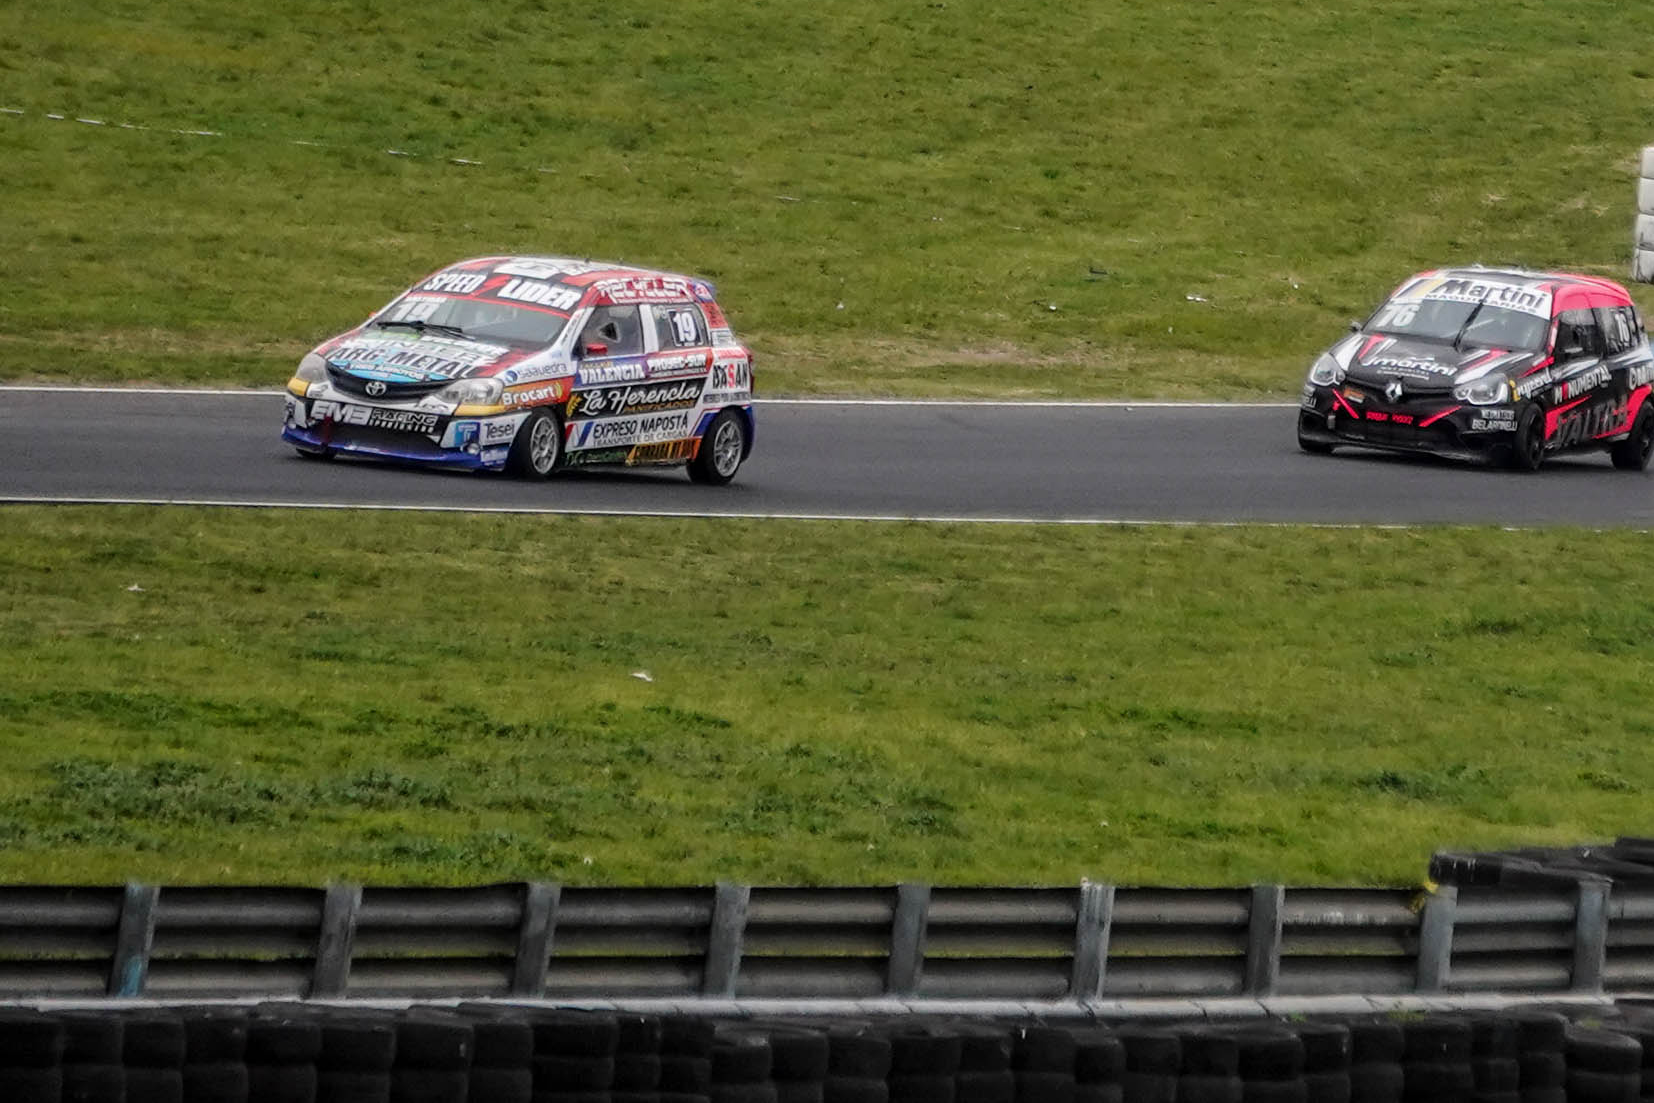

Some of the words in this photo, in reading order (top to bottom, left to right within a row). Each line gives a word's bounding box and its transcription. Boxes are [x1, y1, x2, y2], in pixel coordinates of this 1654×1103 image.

[422, 272, 488, 294] SPEED
[496, 278, 582, 311] LIDER
[1430, 279, 1547, 309] Martini
[672, 311, 698, 343] 19
[388, 351, 476, 380] METAL
[579, 364, 646, 386] VALENCIA
[502, 385, 555, 405] Brocart
[371, 409, 439, 427] RACING
[485, 419, 515, 439] Tesei
[592, 421, 637, 439] EXPRESO
[640, 411, 689, 434] NAPOSTÁ
[656, 429, 689, 443] CARGAS
